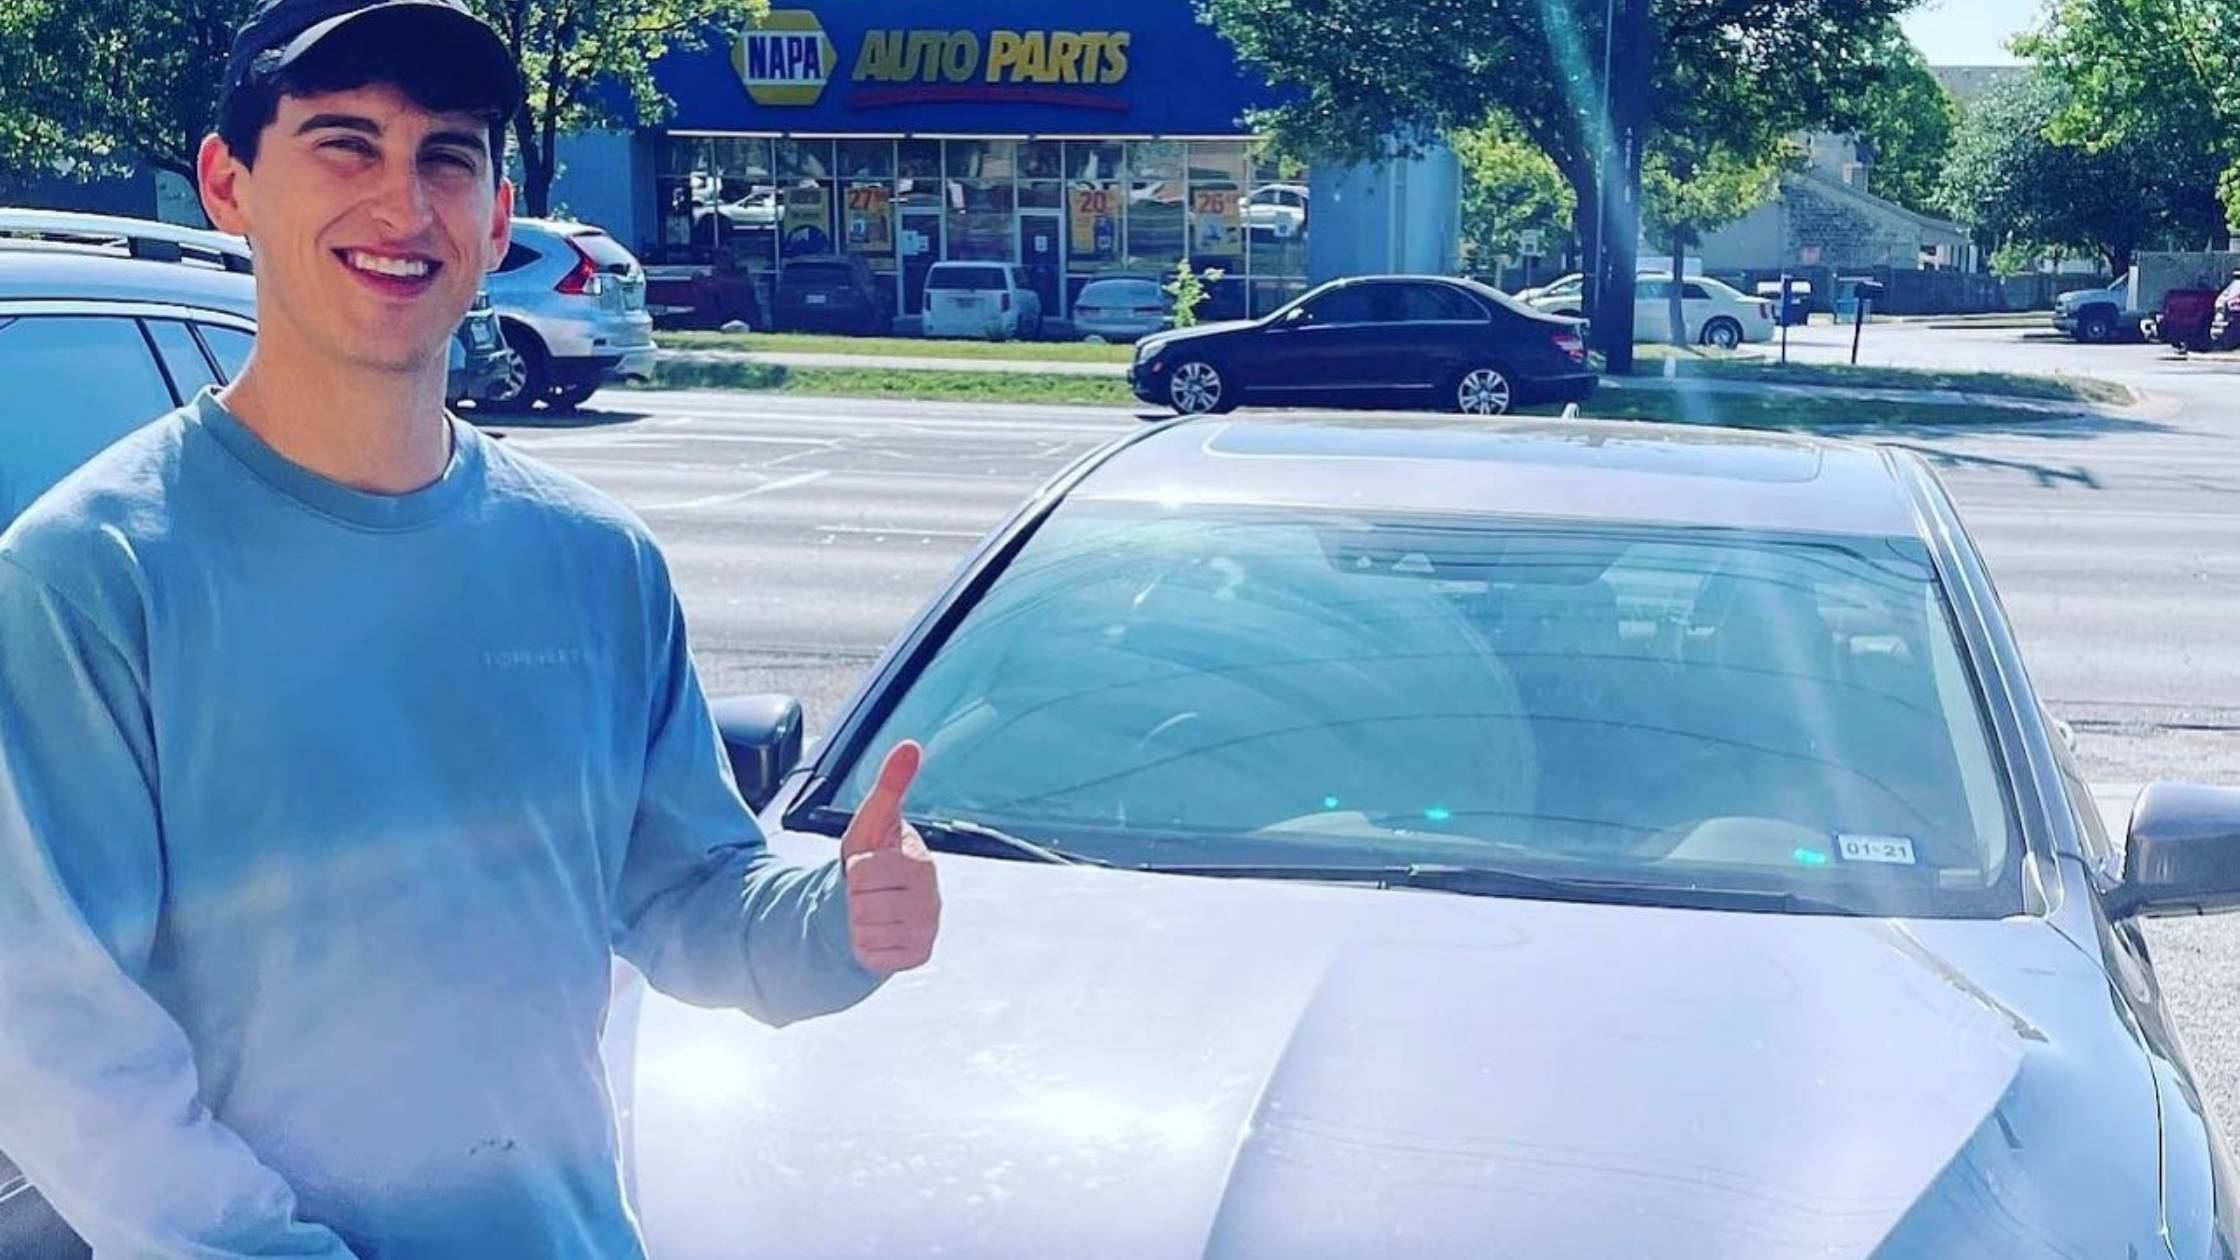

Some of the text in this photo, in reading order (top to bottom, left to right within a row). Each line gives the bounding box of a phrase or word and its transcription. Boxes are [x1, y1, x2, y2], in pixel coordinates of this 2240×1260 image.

[748, 35, 821, 80] NAPA
[852, 30, 1130, 84] AUTO PARTS
